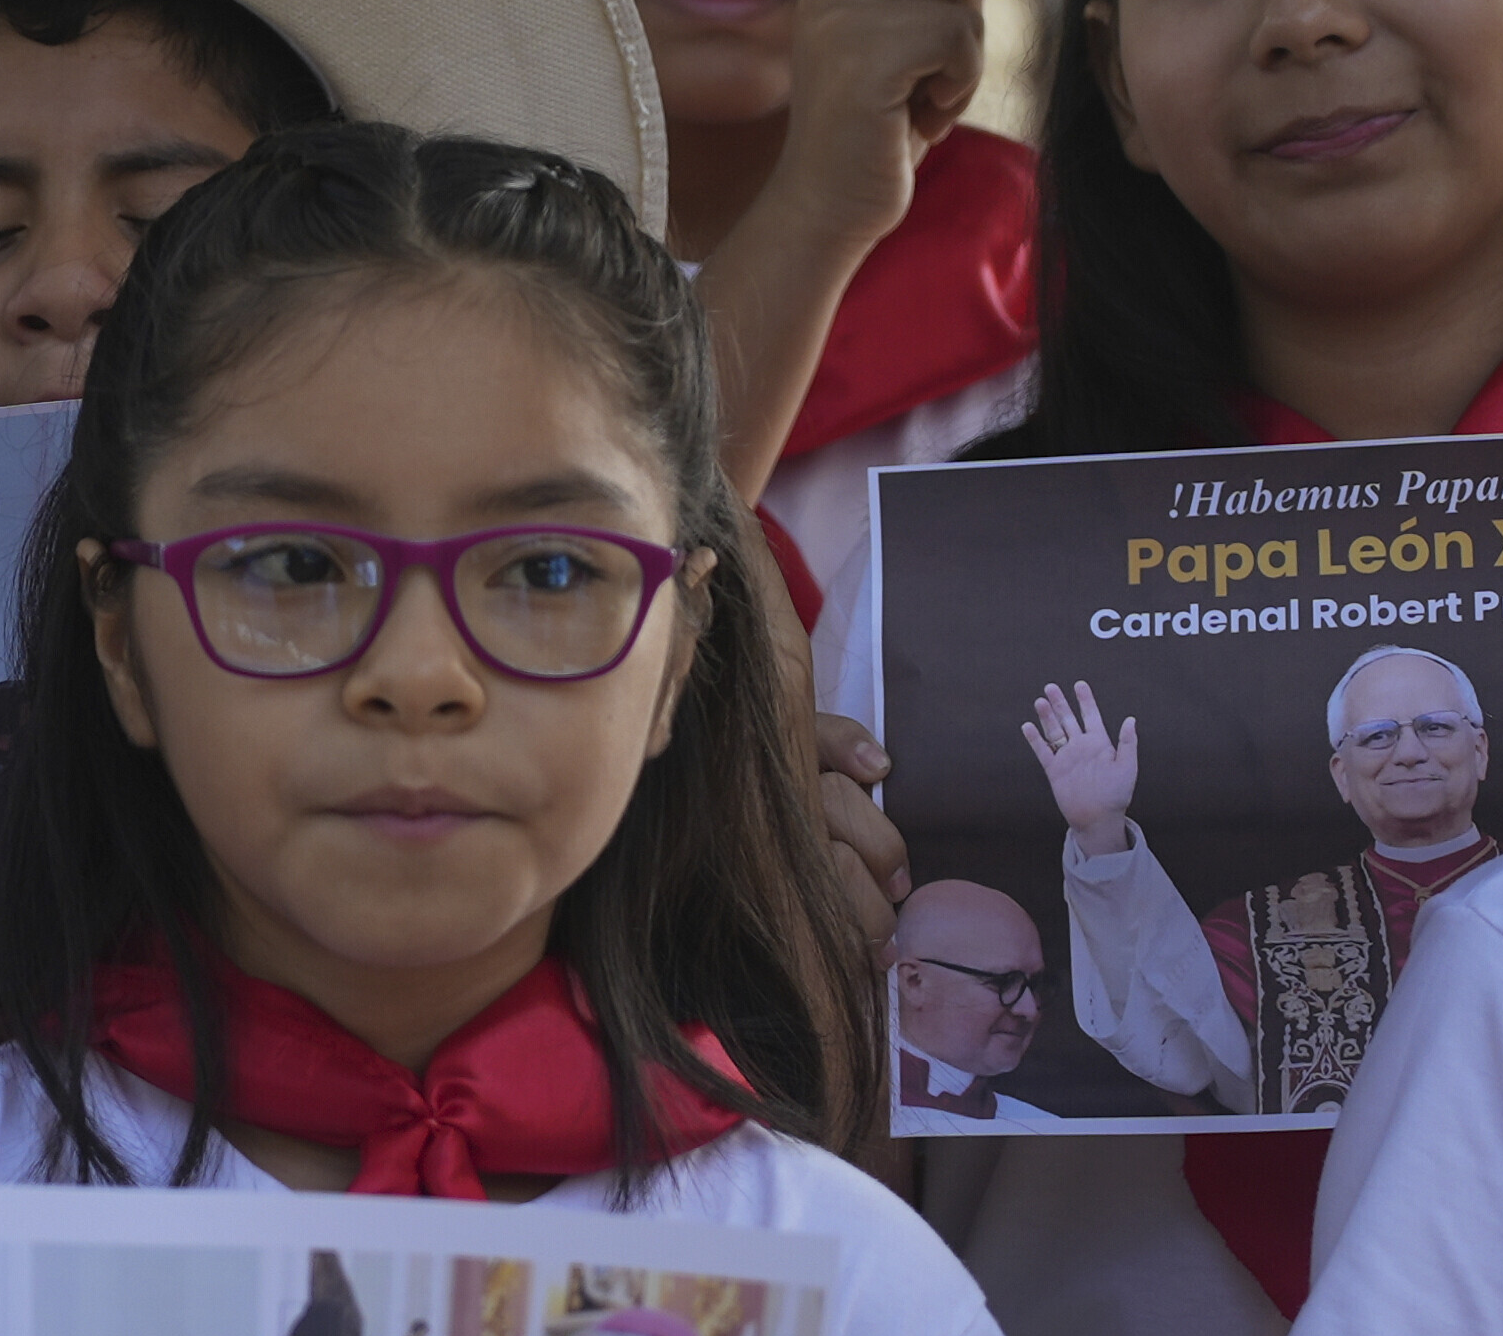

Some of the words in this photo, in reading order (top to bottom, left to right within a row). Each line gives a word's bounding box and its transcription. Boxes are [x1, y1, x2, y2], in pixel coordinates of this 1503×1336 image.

[1128, 538, 1298, 597] Papa
[1318, 516, 1474, 576] León
[1089, 598, 1300, 641] Cardenal
[1312, 592, 1463, 629] Robert
